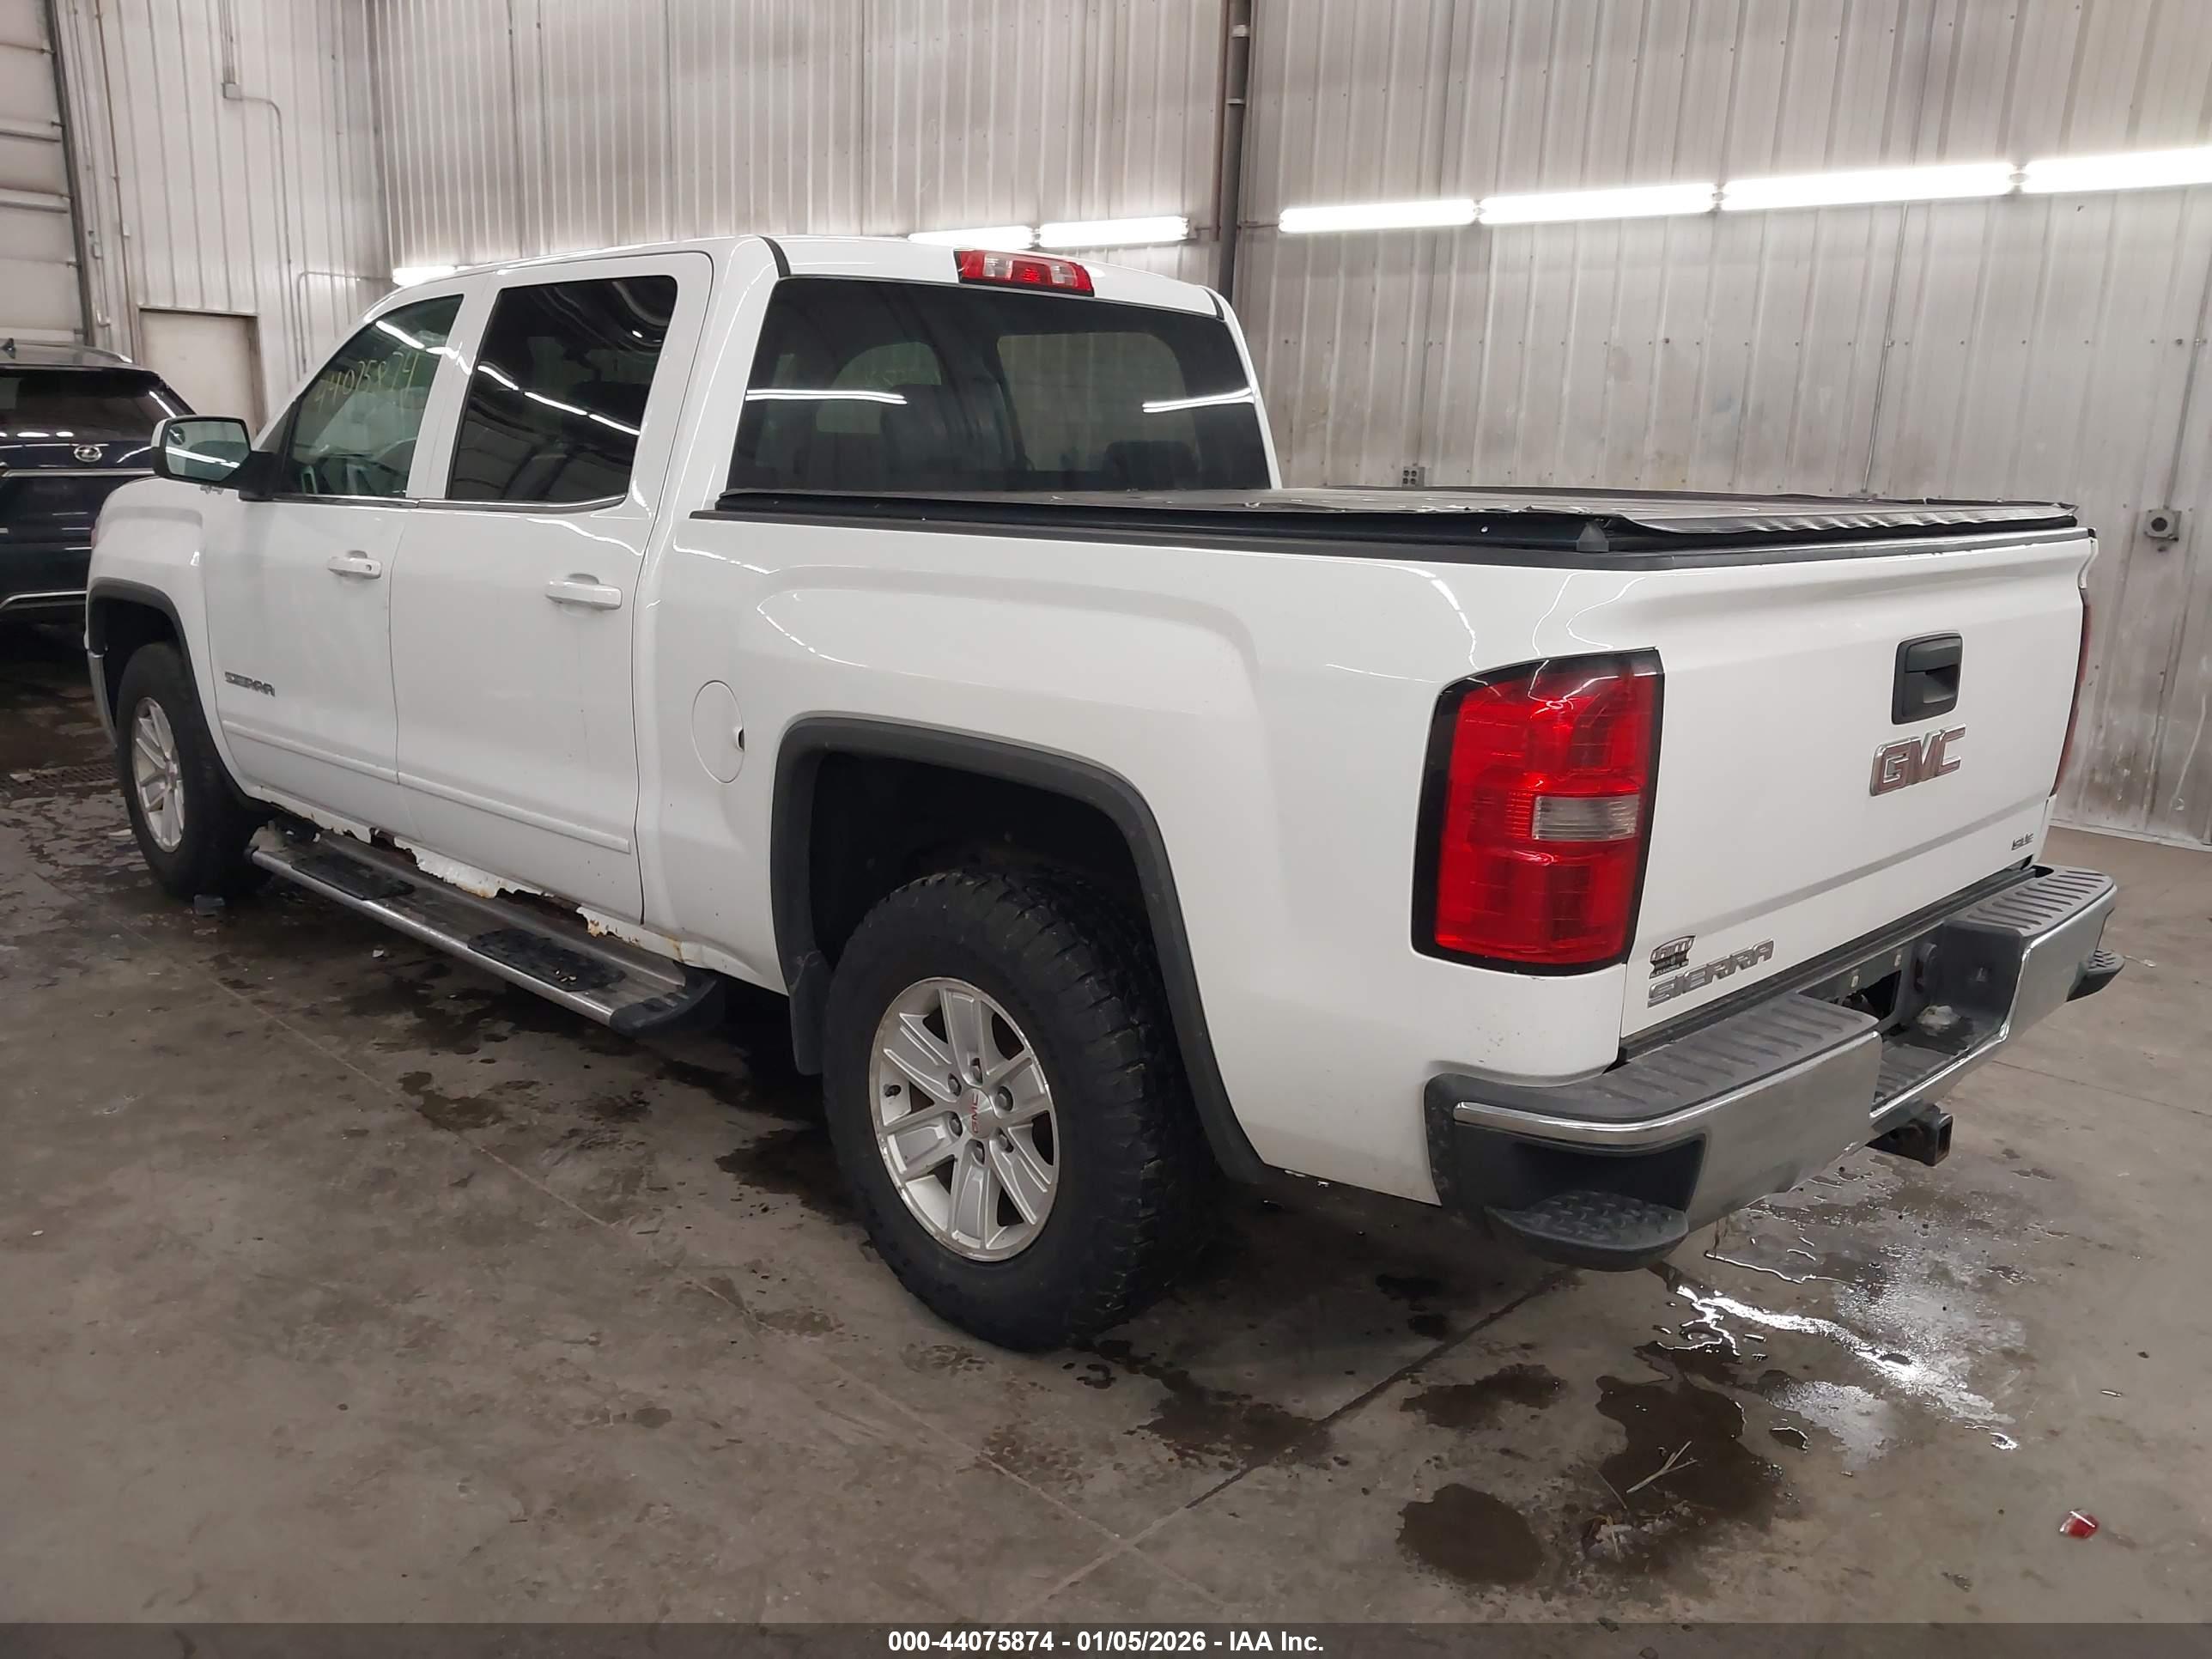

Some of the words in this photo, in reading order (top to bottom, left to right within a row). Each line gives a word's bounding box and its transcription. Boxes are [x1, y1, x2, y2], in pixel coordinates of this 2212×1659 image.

[224, 671, 276, 697] SIERRA
[1869, 723, 1967, 797] GMC
[1647, 938, 1775, 1009] SIERRA
